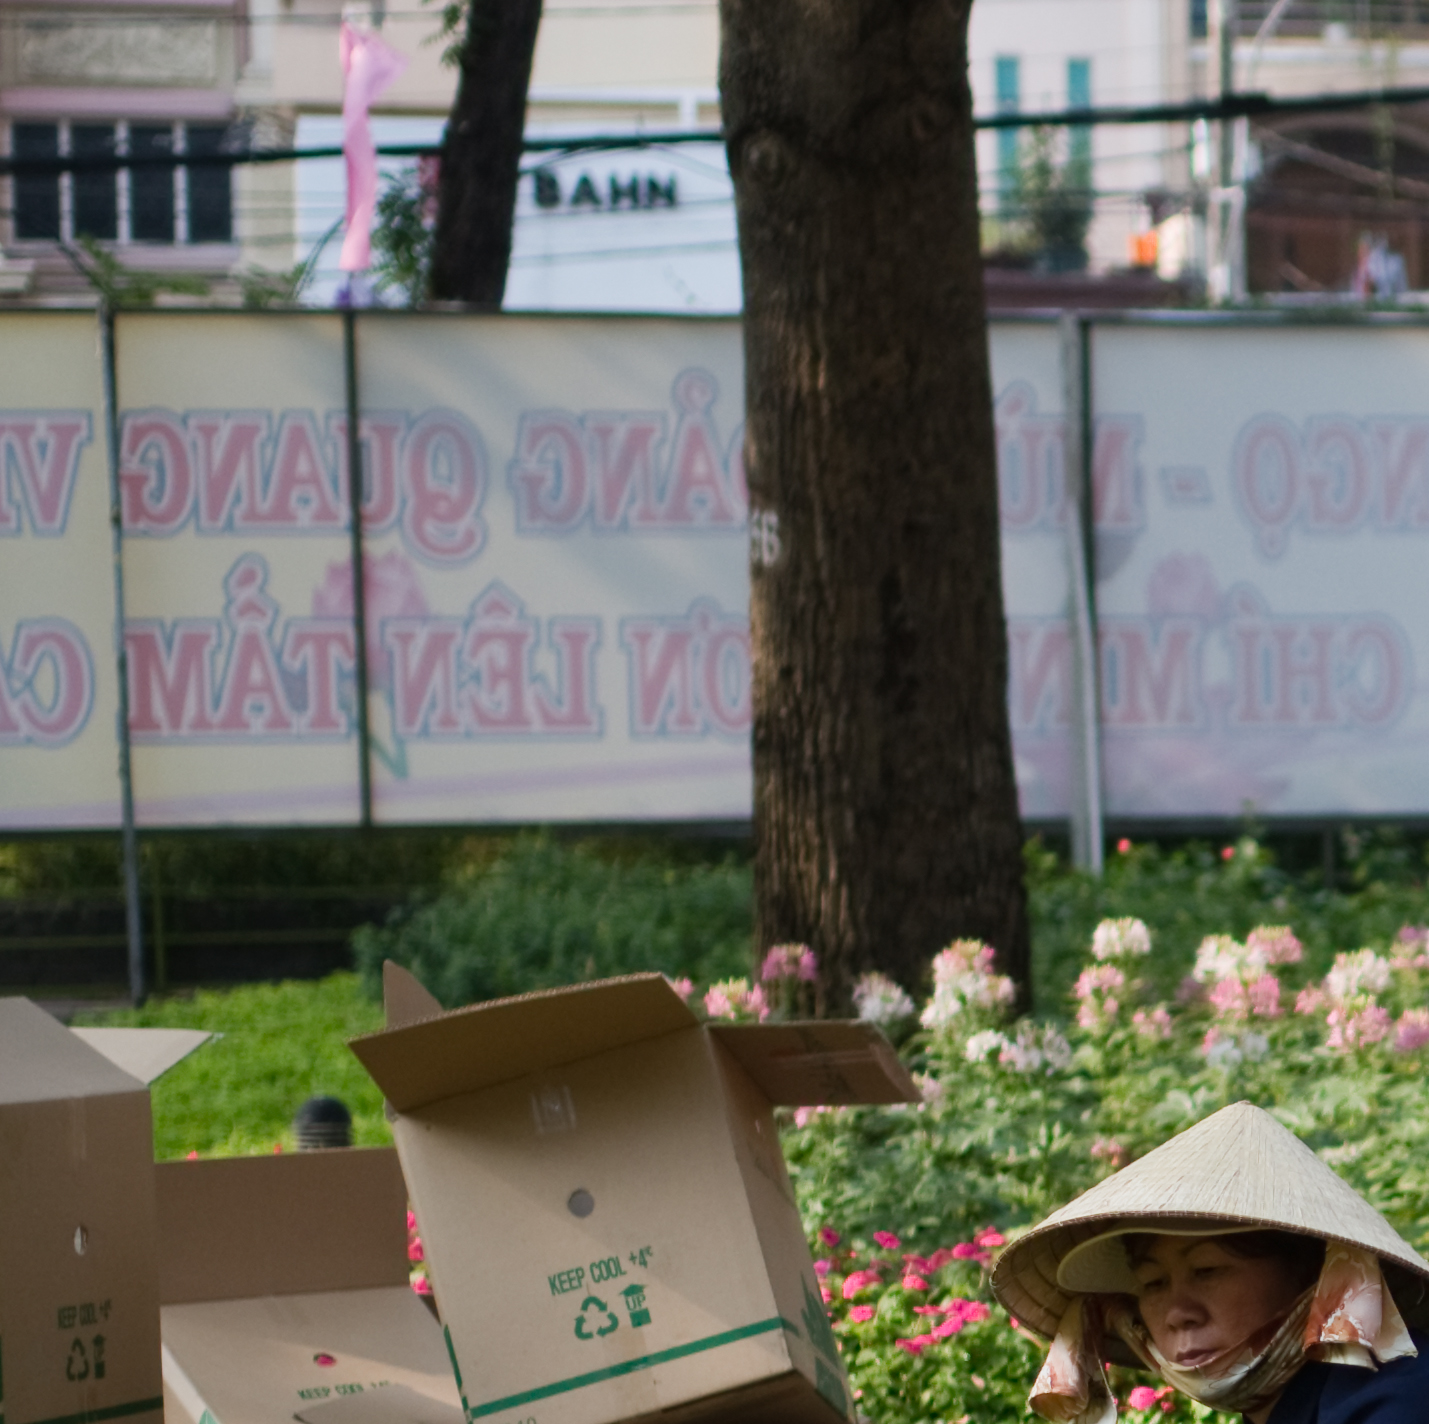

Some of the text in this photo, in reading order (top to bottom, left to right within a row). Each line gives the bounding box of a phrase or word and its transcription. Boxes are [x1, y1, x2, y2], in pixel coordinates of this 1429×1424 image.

[547, 1266, 586, 1296] KEEP
[589, 1256, 628, 1284] COOL
[625, 1294, 646, 1312] UP
